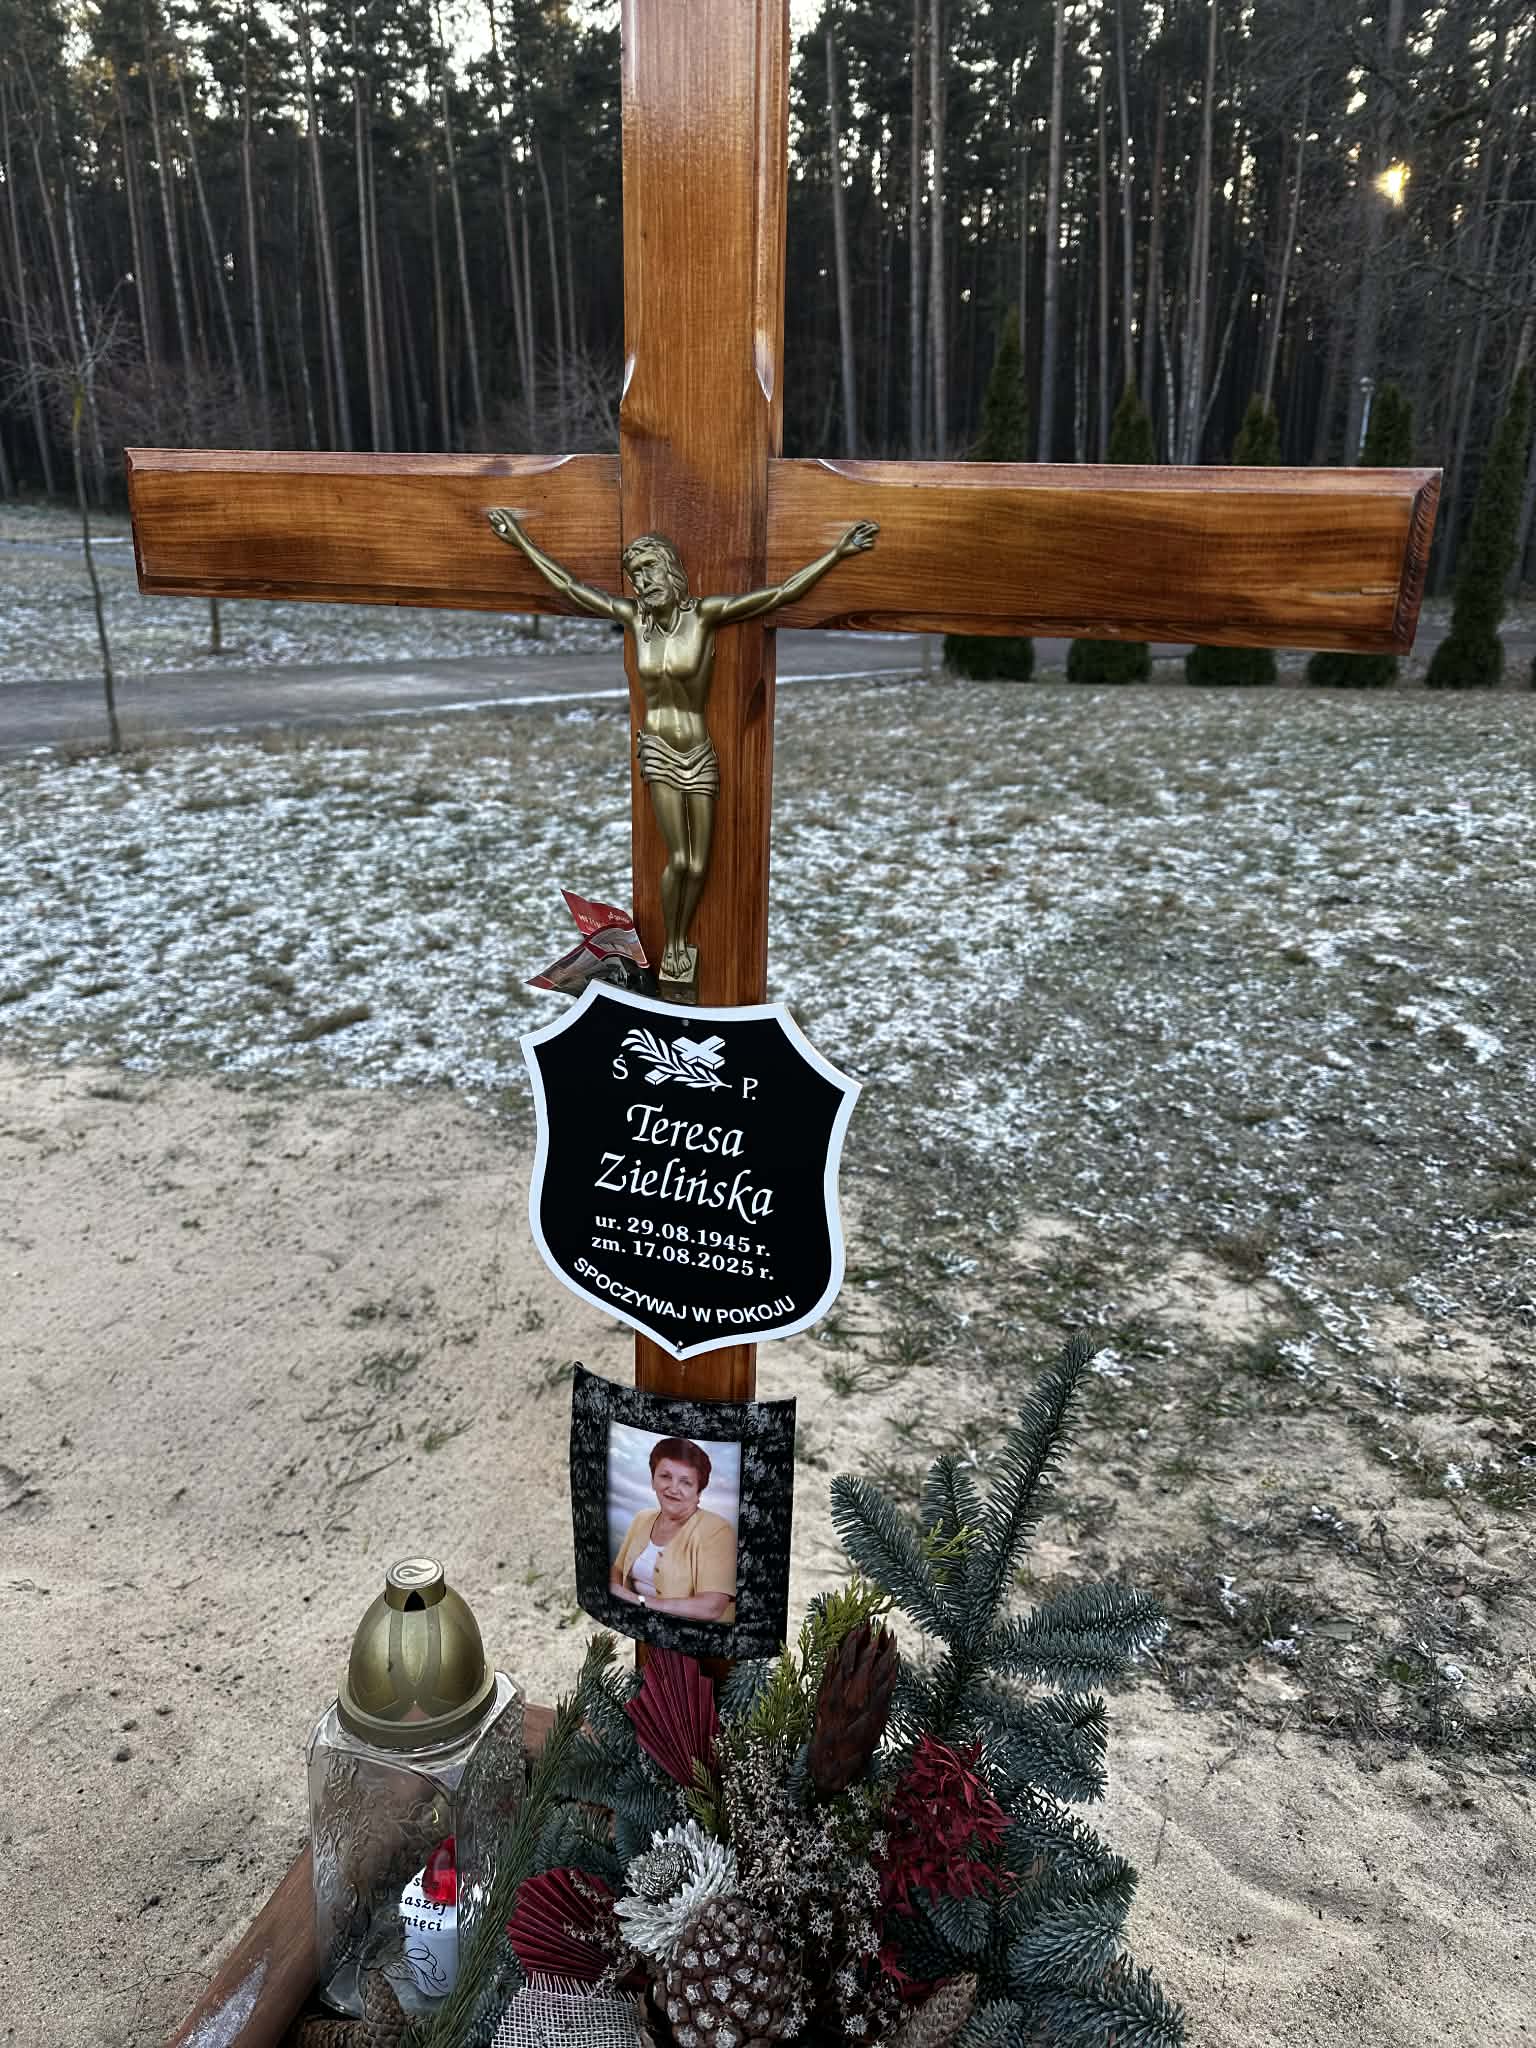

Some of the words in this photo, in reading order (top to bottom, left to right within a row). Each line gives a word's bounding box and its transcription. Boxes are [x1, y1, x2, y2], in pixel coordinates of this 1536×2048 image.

[612, 1053, 629, 1080] Ś
[742, 1077, 759, 1101] P.
[626, 1103, 745, 1158] Teresa
[594, 1151, 774, 1225] Zielińska
[591, 1236, 626, 1253] zm.
[633, 1240, 754, 1276] 17.08.2025
[759, 1267, 774, 1281] r.
[595, 1215, 622, 1231] ur.
[627, 1216, 751, 1253] 29.08.1945
[756, 1244, 771, 1257] r.
[573, 1257, 687, 1320] SPOCZYWAJ
[691, 1306, 712, 1323] W
[715, 1295, 796, 1324] POKOJU
[400, 1896, 448, 1916] aszej
